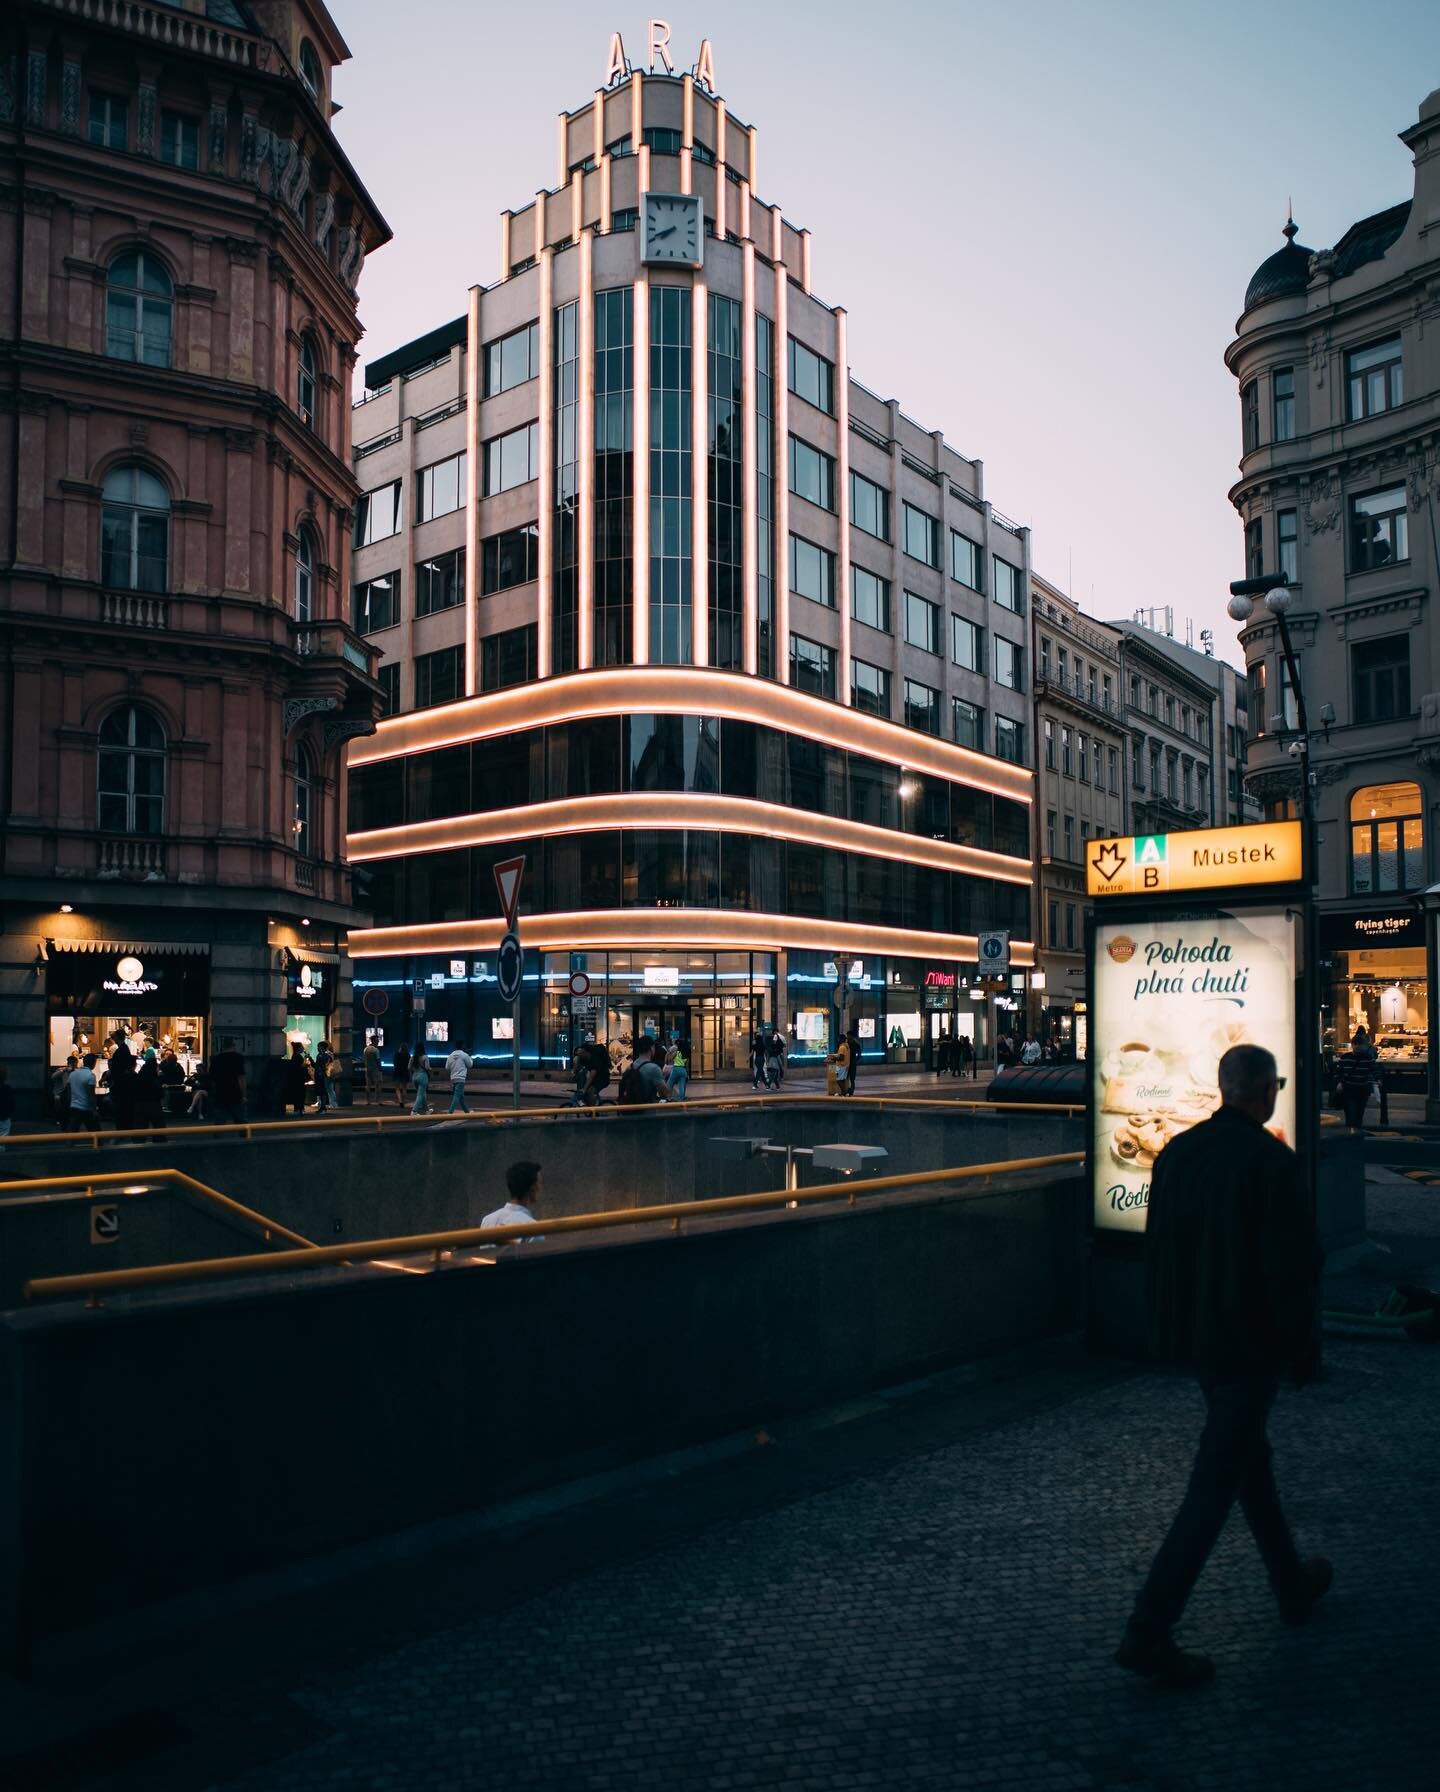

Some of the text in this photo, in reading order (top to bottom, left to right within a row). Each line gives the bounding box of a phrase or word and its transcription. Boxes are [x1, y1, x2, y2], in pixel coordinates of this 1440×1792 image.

[606, 18, 717, 93] ARA
[1140, 837, 1161, 862] A
[1097, 883, 1124, 893] Metro
[1144, 868, 1159, 888] B
[1354, 917, 1411, 931] flying tiger
[1144, 936, 1233, 966] Pohoda
[1133, 968, 1185, 1001] plná
[1106, 1182, 1149, 1211] Rodi
